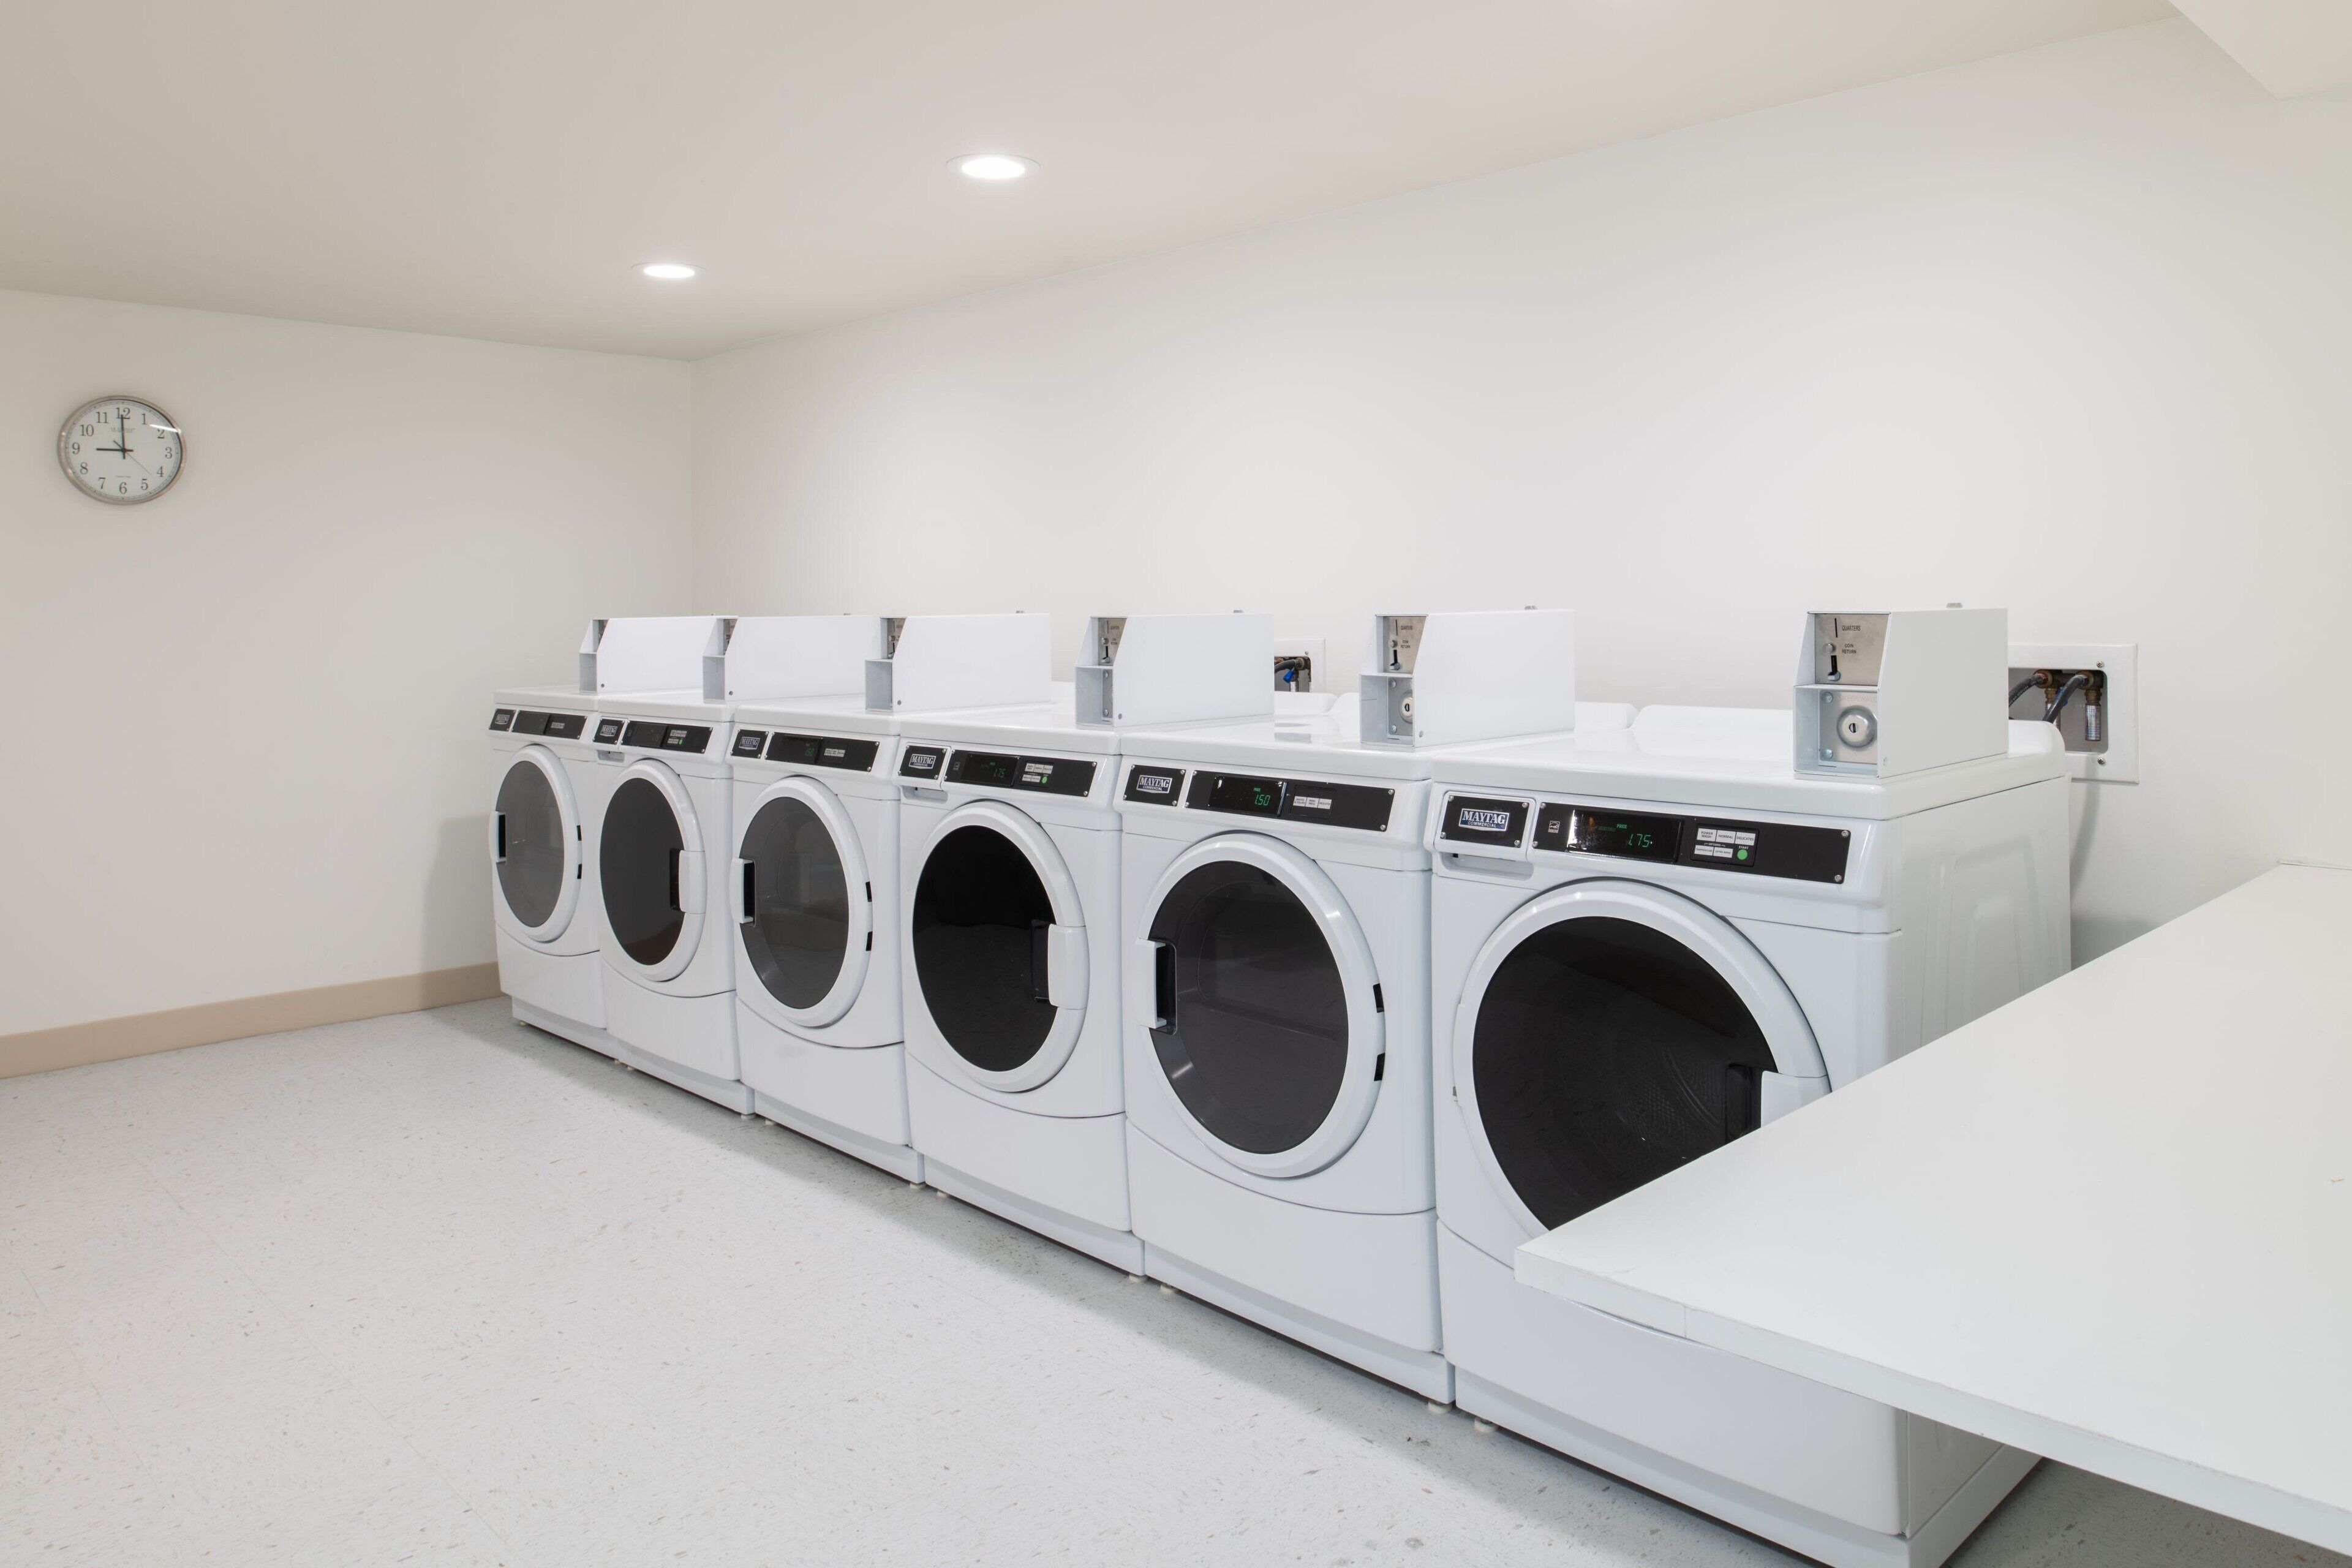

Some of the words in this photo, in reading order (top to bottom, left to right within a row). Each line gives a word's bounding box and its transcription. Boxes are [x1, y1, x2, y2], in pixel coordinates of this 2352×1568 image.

[96, 412, 109, 424] 11
[116, 407, 130, 420] 12
[141, 413, 148, 424] 1
[80, 424, 94, 437] 10
[157, 428, 165, 439] 2
[72, 442, 80, 454] 9
[165, 447, 173, 459] 3
[80, 462, 88, 475] 8
[157, 466, 164, 477] 4
[98, 477, 106, 489] 7
[119, 482, 127, 495] 6
[141, 478, 148, 491] 5
[911, 755, 934, 764] MAYTAG
[1140, 777, 1170, 788] MAYTAG
[1462, 810, 1506, 824] MAYTAG
